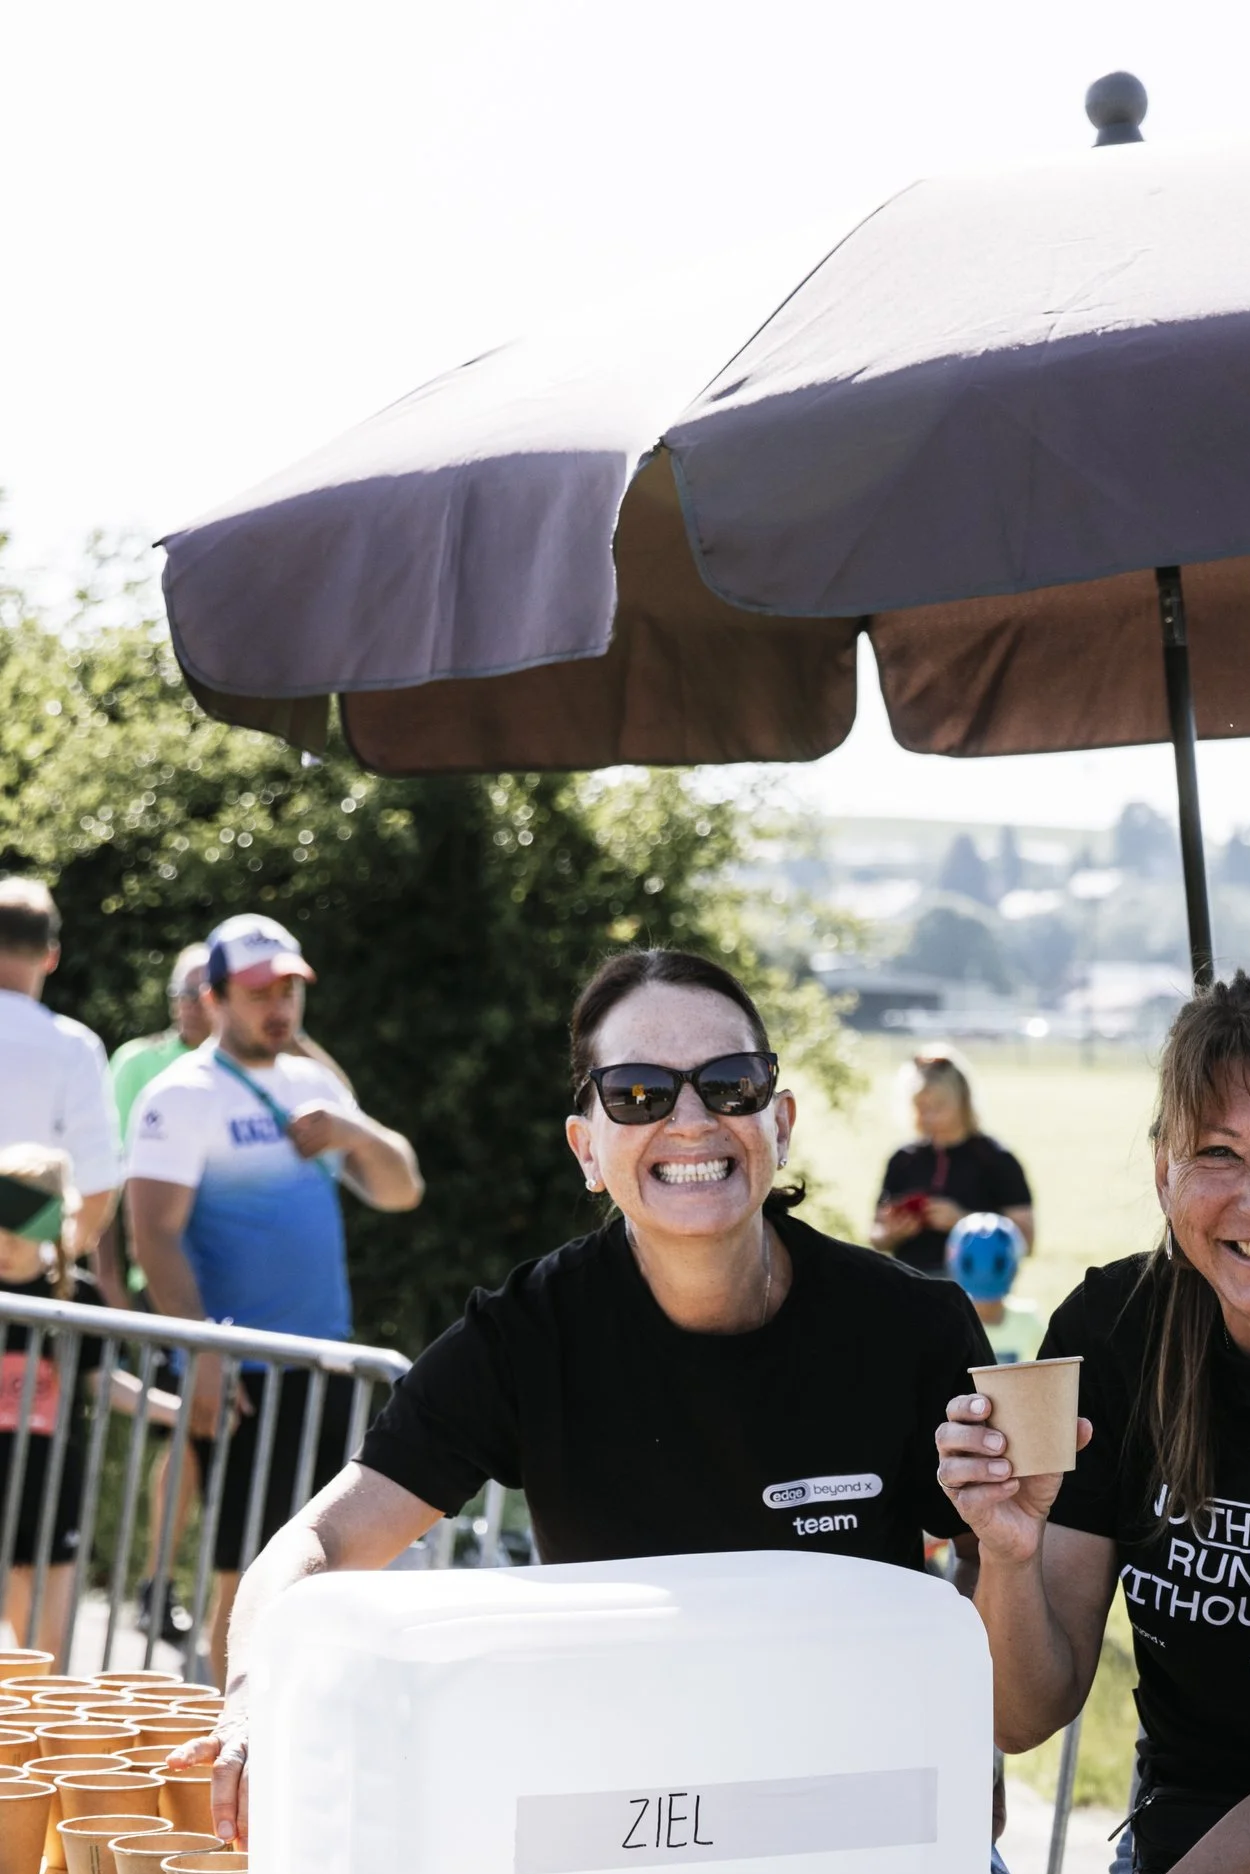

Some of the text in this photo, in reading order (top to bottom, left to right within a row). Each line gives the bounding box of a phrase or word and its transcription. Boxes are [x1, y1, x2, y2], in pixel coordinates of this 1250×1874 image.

[813, 1481, 861, 1497] beyond
[864, 1482, 873, 1491] x
[792, 1513, 858, 1536] team
[621, 1792, 714, 1849] ZIEL
